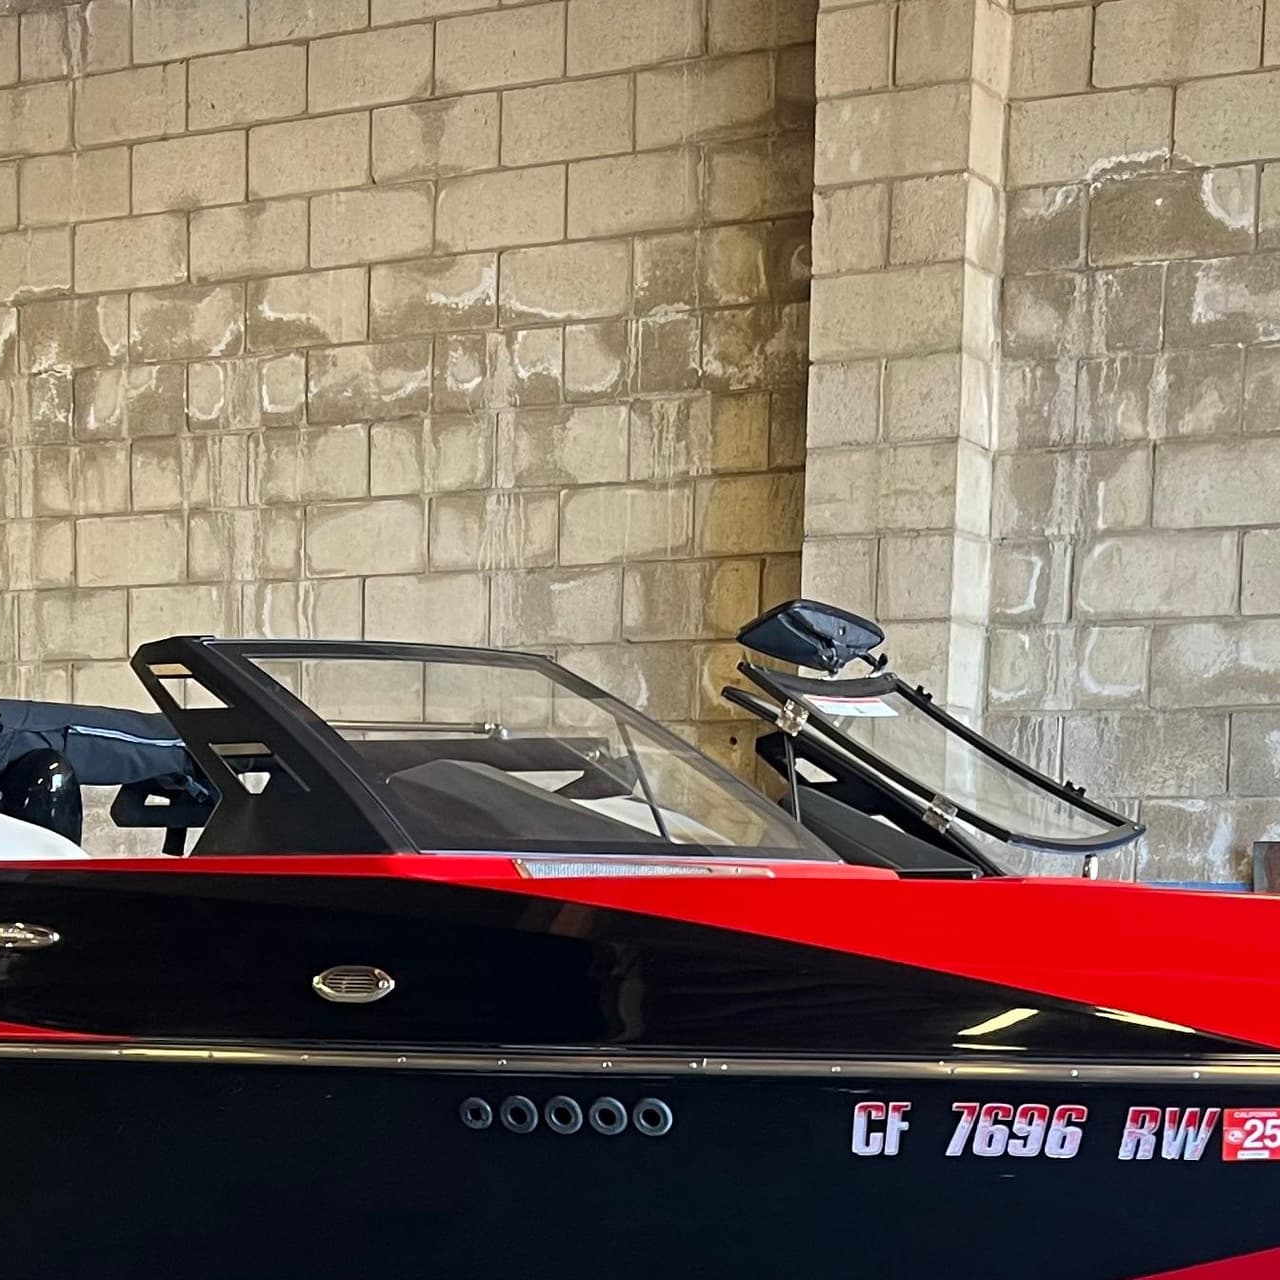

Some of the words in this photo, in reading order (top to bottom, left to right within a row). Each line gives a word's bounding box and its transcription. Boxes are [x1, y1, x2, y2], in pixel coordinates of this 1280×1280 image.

[851, 1101, 912, 1157] CF
[944, 1102, 1089, 1159] 7696
[1117, 1106, 1222, 1162] RW
